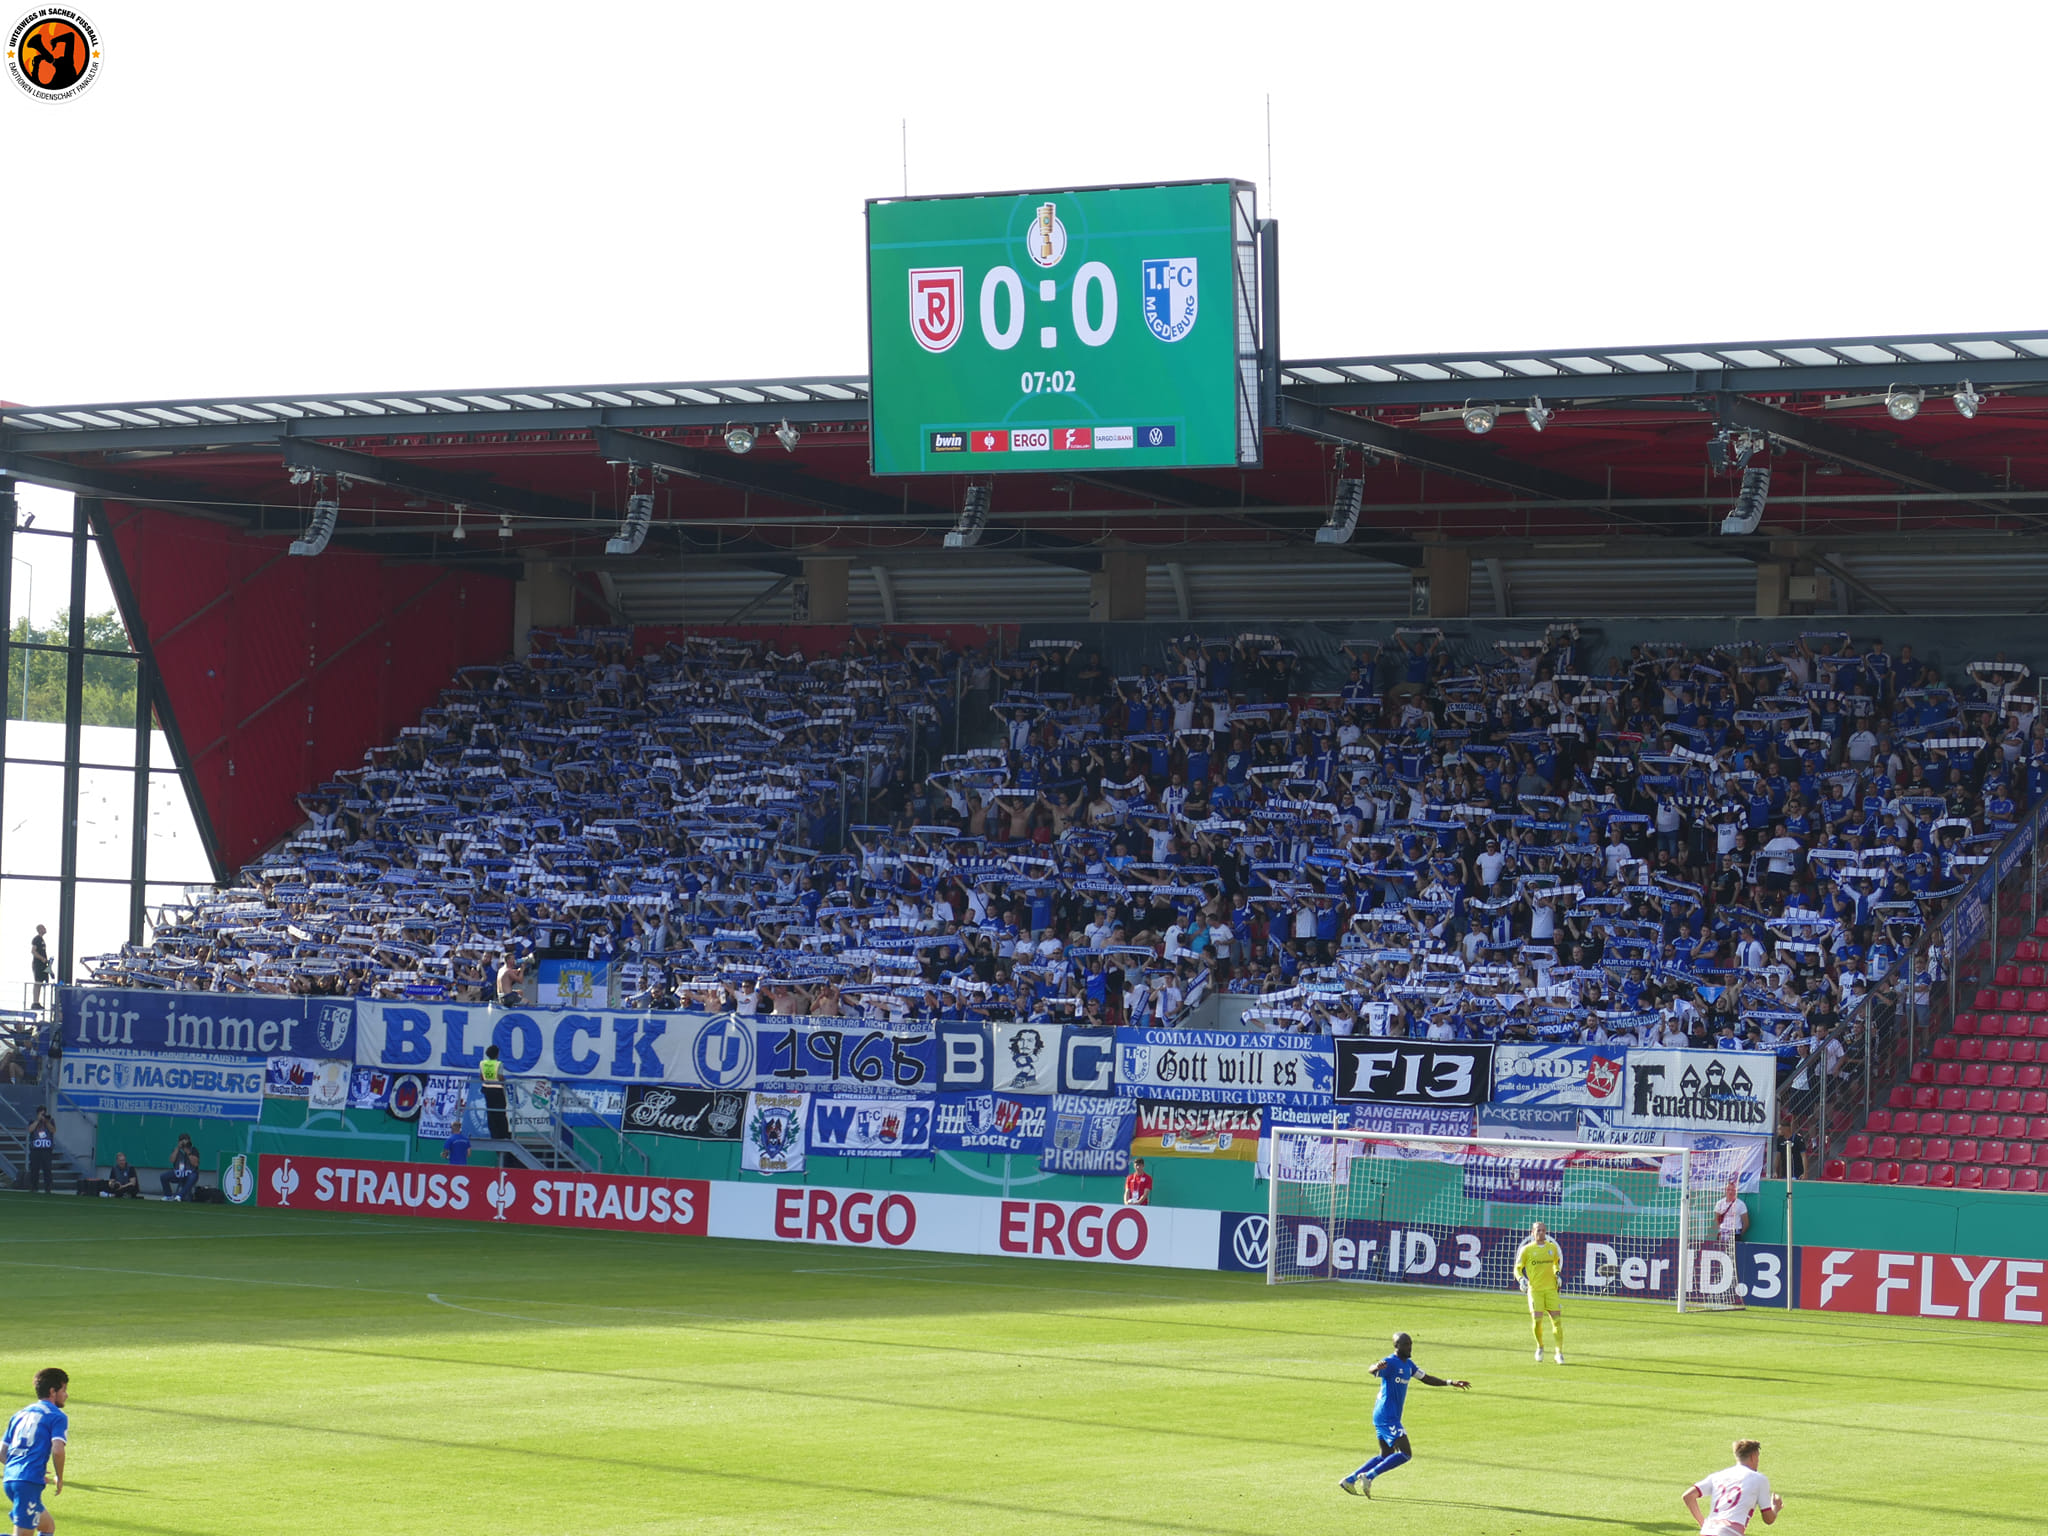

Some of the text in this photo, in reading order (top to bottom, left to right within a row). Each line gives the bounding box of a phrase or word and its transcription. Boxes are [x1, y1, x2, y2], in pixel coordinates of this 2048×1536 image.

[1146, 295, 1195, 337] MAGDEBURG
[1021, 370, 1076, 394] 07:02
[936, 433, 962, 447] bwin
[1013, 433, 1047, 447] ERGO
[1416, 581, 1425, 594] N
[1417, 598, 1424, 610] 2
[76, 994, 298, 1052] für immer
[766, 1016, 935, 1032] NOCH IST MAGDEBURG NICHT VERLOREN
[381, 1008, 667, 1078] BLOCK
[1145, 1031, 1312, 1050] COMMANDO EAST SIDE
[773, 1028, 928, 1087] 1965
[943, 1032, 1113, 1090] B G
[1157, 1049, 1298, 1086] Gott will es
[1497, 1051, 1588, 1079] BÖRDE
[63, 1063, 261, 1094] 1.FC MAGDEBURG
[99, 1096, 223, 1114] FÜR UNSERE FESTUNGSSTADT
[1052, 1094, 1137, 1116] WEISSENFELS
[1117, 1086, 1144, 1099] 1.FC
[1149, 1087, 1243, 1104] MAGDEBURG
[1247, 1088, 1286, 1105] ÜBER
[1631, 1064, 1767, 1125] Fanatismus
[817, 1105, 930, 1145] W B
[1140, 1105, 1263, 1131] WEISSENFELS
[1271, 1106, 1350, 1125] Eichenweiler
[1355, 1105, 1470, 1122] SANGERHAUSEN
[1482, 1104, 1574, 1123] ACKERFRONT
[1354, 1119, 1392, 1133] CLUB
[1428, 1123, 1469, 1137] FANS
[1588, 1129, 1656, 1144] FCM FAN CLUB
[962, 1134, 1022, 1149] BLOCK U
[1044, 1148, 1128, 1171] PIRANHAS
[314, 1166, 471, 1210] STRAUSS
[531, 1179, 695, 1225] STRAUSS
[774, 1187, 917, 1246] ERGO
[999, 1201, 1149, 1261] ERGO
[1296, 1224, 1482, 1279] Der ID.3
[1584, 1243, 1782, 1299] Der ID.3
